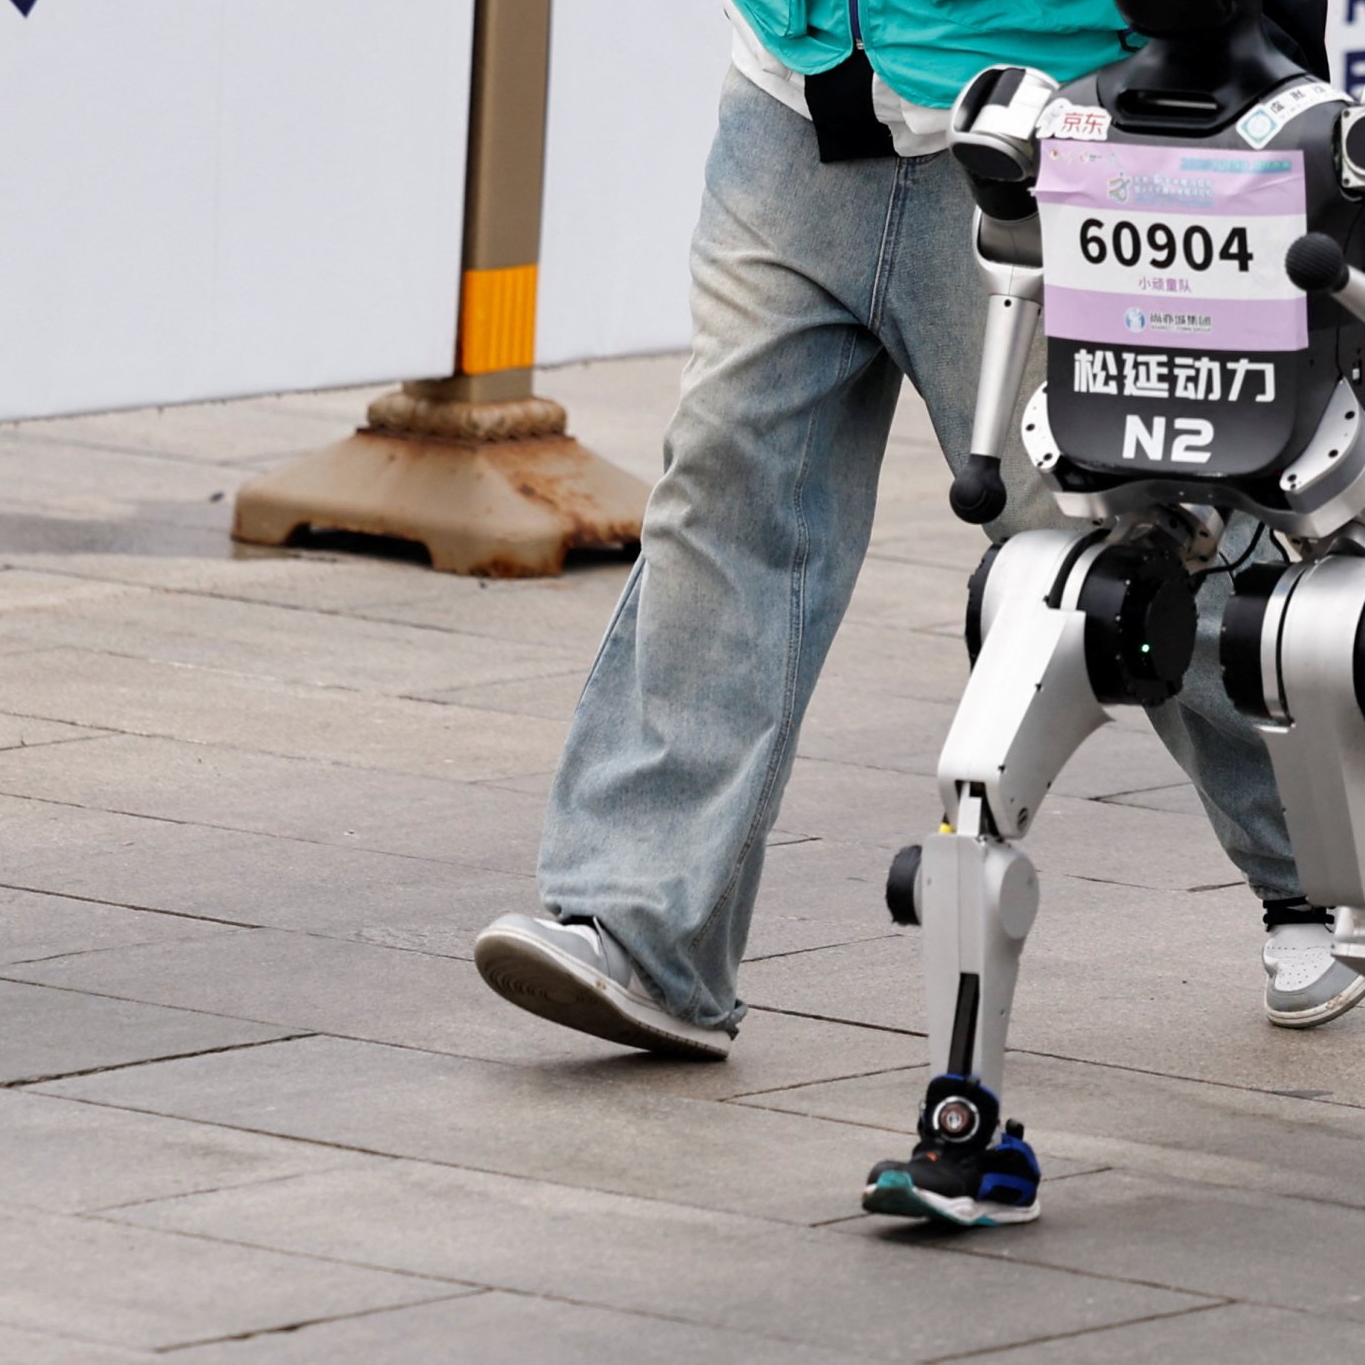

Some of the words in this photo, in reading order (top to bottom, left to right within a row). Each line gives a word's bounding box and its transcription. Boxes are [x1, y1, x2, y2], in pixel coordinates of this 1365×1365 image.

[1061, 112, 1106, 135] 京东
[1079, 218, 1254, 272] 60904
[1073, 348, 1276, 403] 松延动力
[1122, 414, 1214, 464] N2
